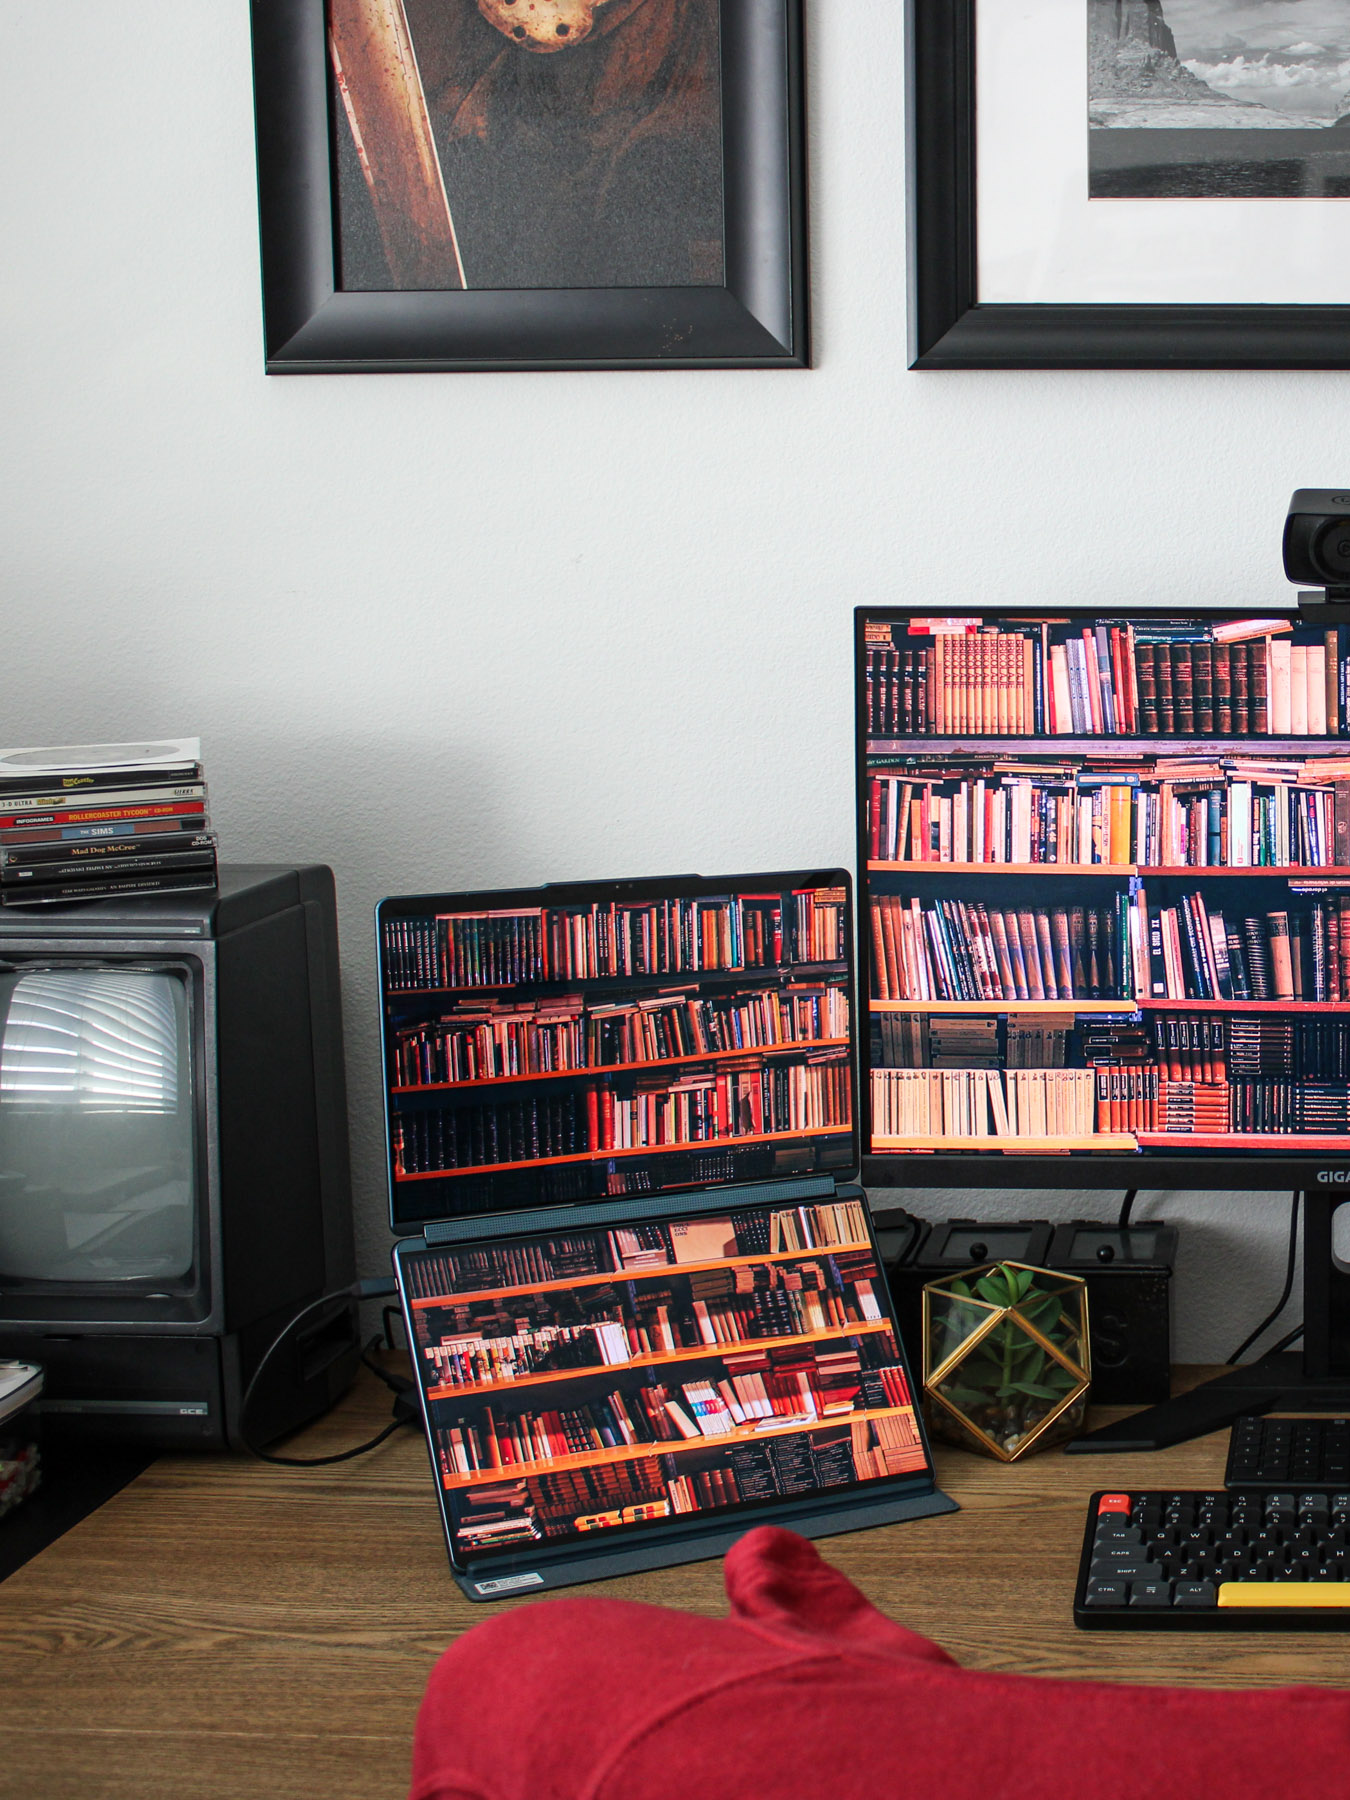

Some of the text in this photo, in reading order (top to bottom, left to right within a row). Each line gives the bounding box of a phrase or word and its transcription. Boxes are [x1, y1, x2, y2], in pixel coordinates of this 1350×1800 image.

[16, 816, 54, 825] INFOGRAMES
[68, 810, 122, 821] ROLLERCOASTER
[91, 827, 114, 836] SIMS
[90, 847, 106, 856] Dog
[1151, 919, 1160, 928] XX
[1152, 931, 1160, 946] SIGLO
